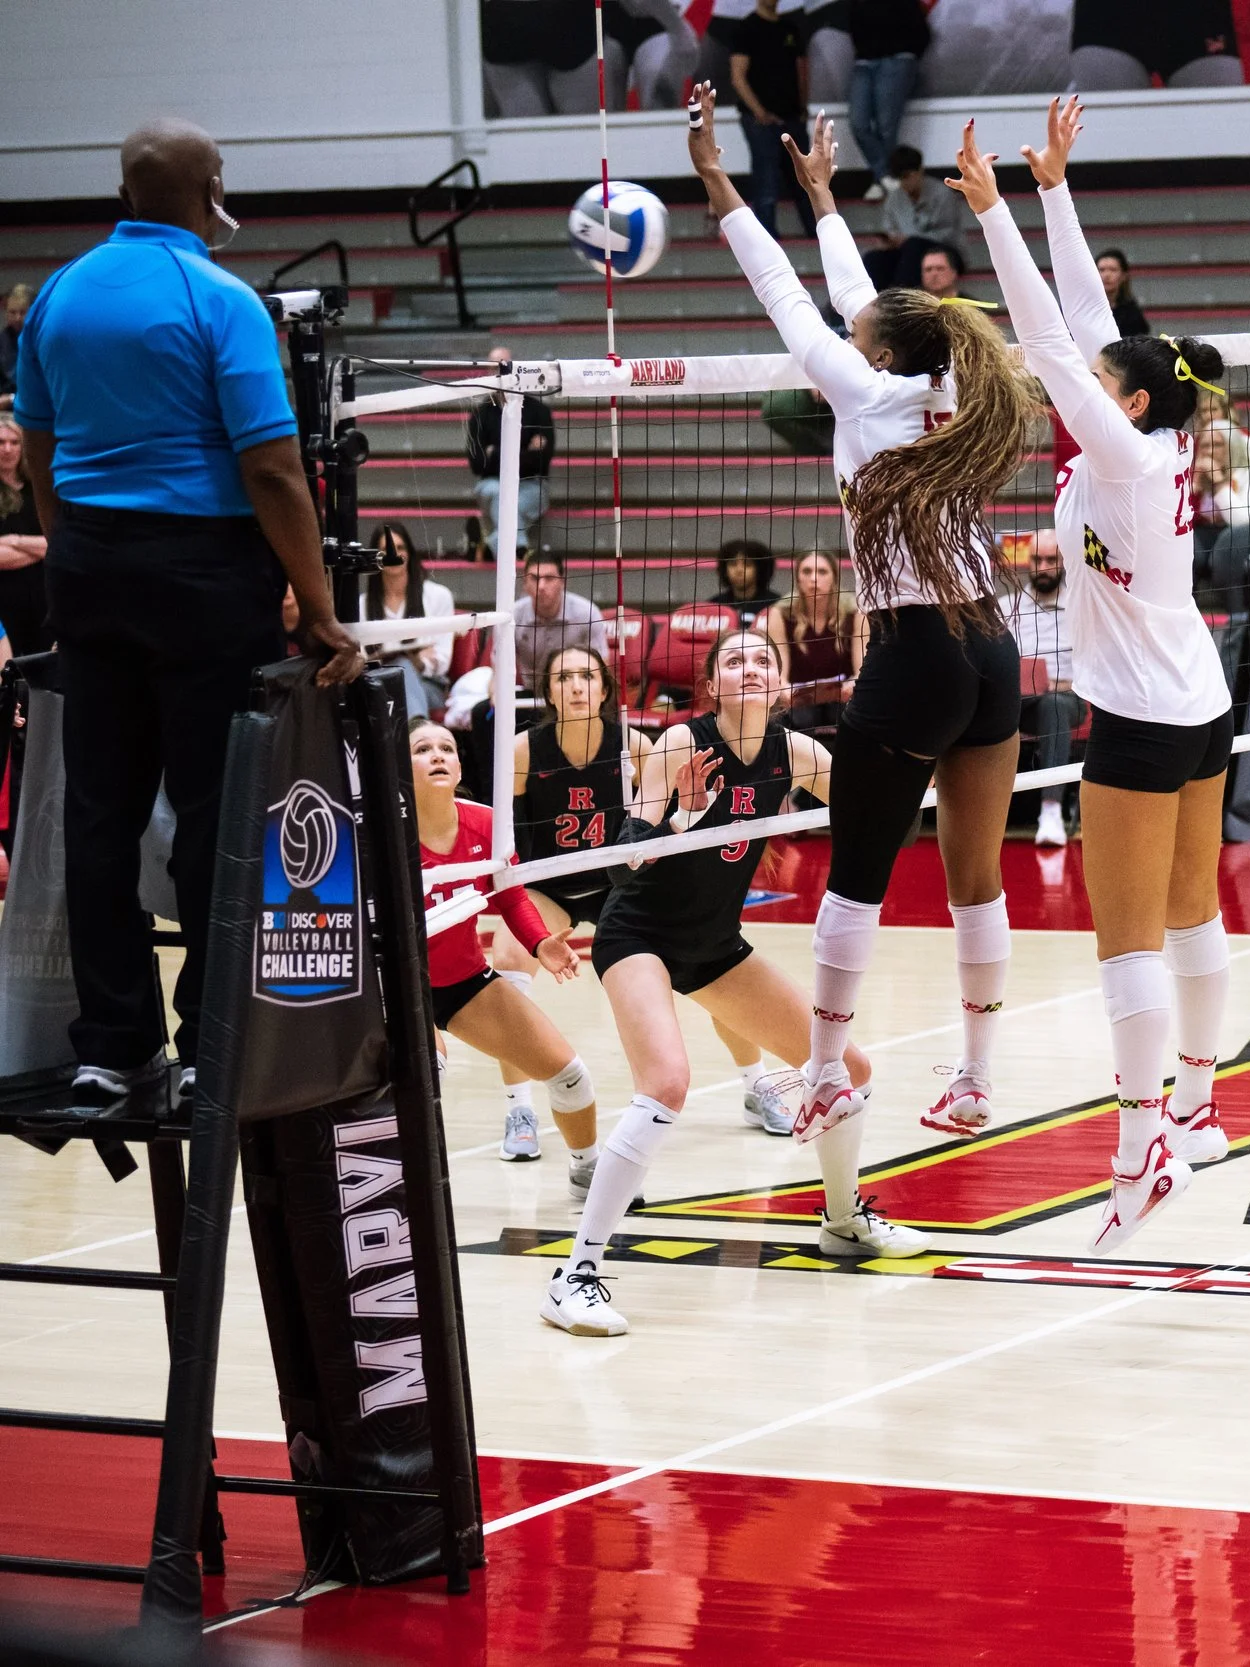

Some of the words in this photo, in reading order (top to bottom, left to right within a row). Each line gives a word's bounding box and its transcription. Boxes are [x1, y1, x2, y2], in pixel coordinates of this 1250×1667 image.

[522, 367, 542, 375] Senoh
[630, 359, 686, 382] MARYLAND
[569, 787, 595, 810] R
[730, 786, 756, 815] R
[555, 812, 605, 848] 24
[291, 912, 353, 929] DISCOVER
[262, 933, 353, 951] VOLLEYBALL
[261, 954, 353, 978] CHALLENGE
